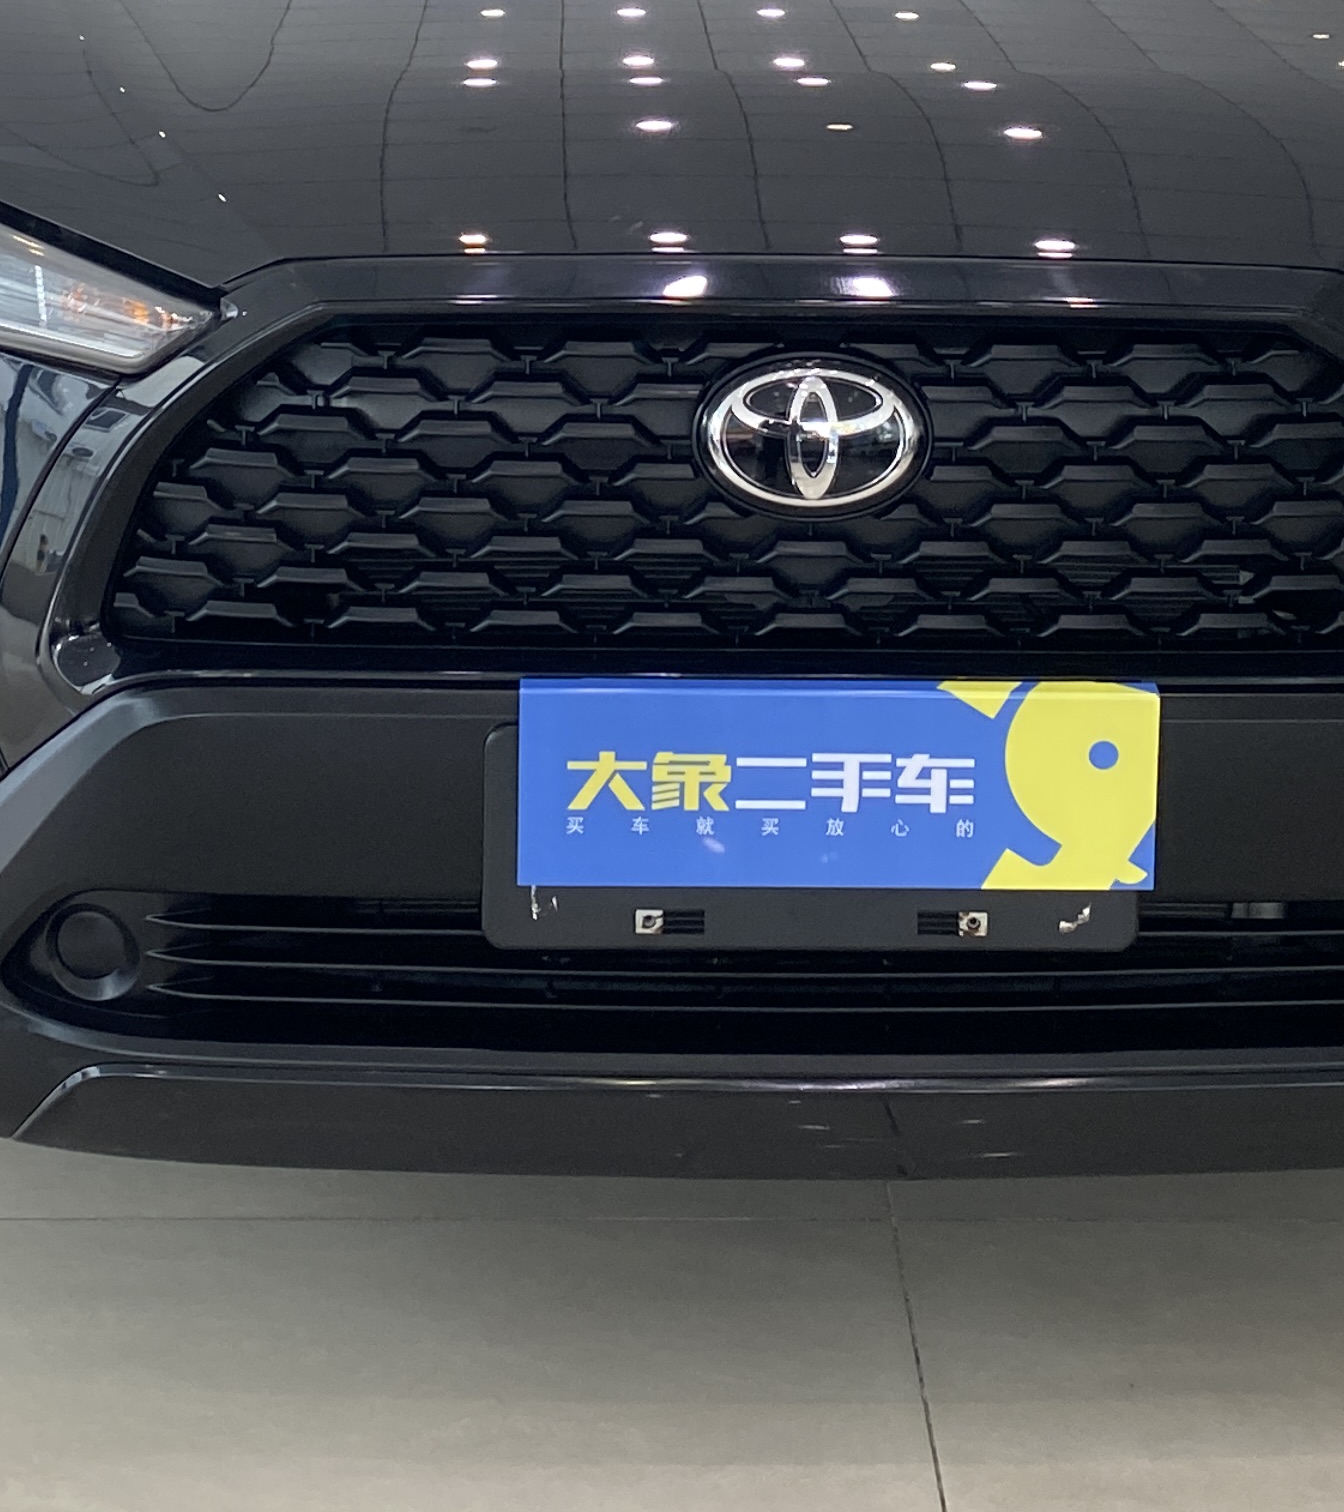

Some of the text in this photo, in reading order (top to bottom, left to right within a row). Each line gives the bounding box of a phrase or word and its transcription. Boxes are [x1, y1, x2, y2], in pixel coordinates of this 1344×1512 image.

[566, 750, 976, 814] 大象二手车
[566, 815, 976, 838] 买车就买放心的
